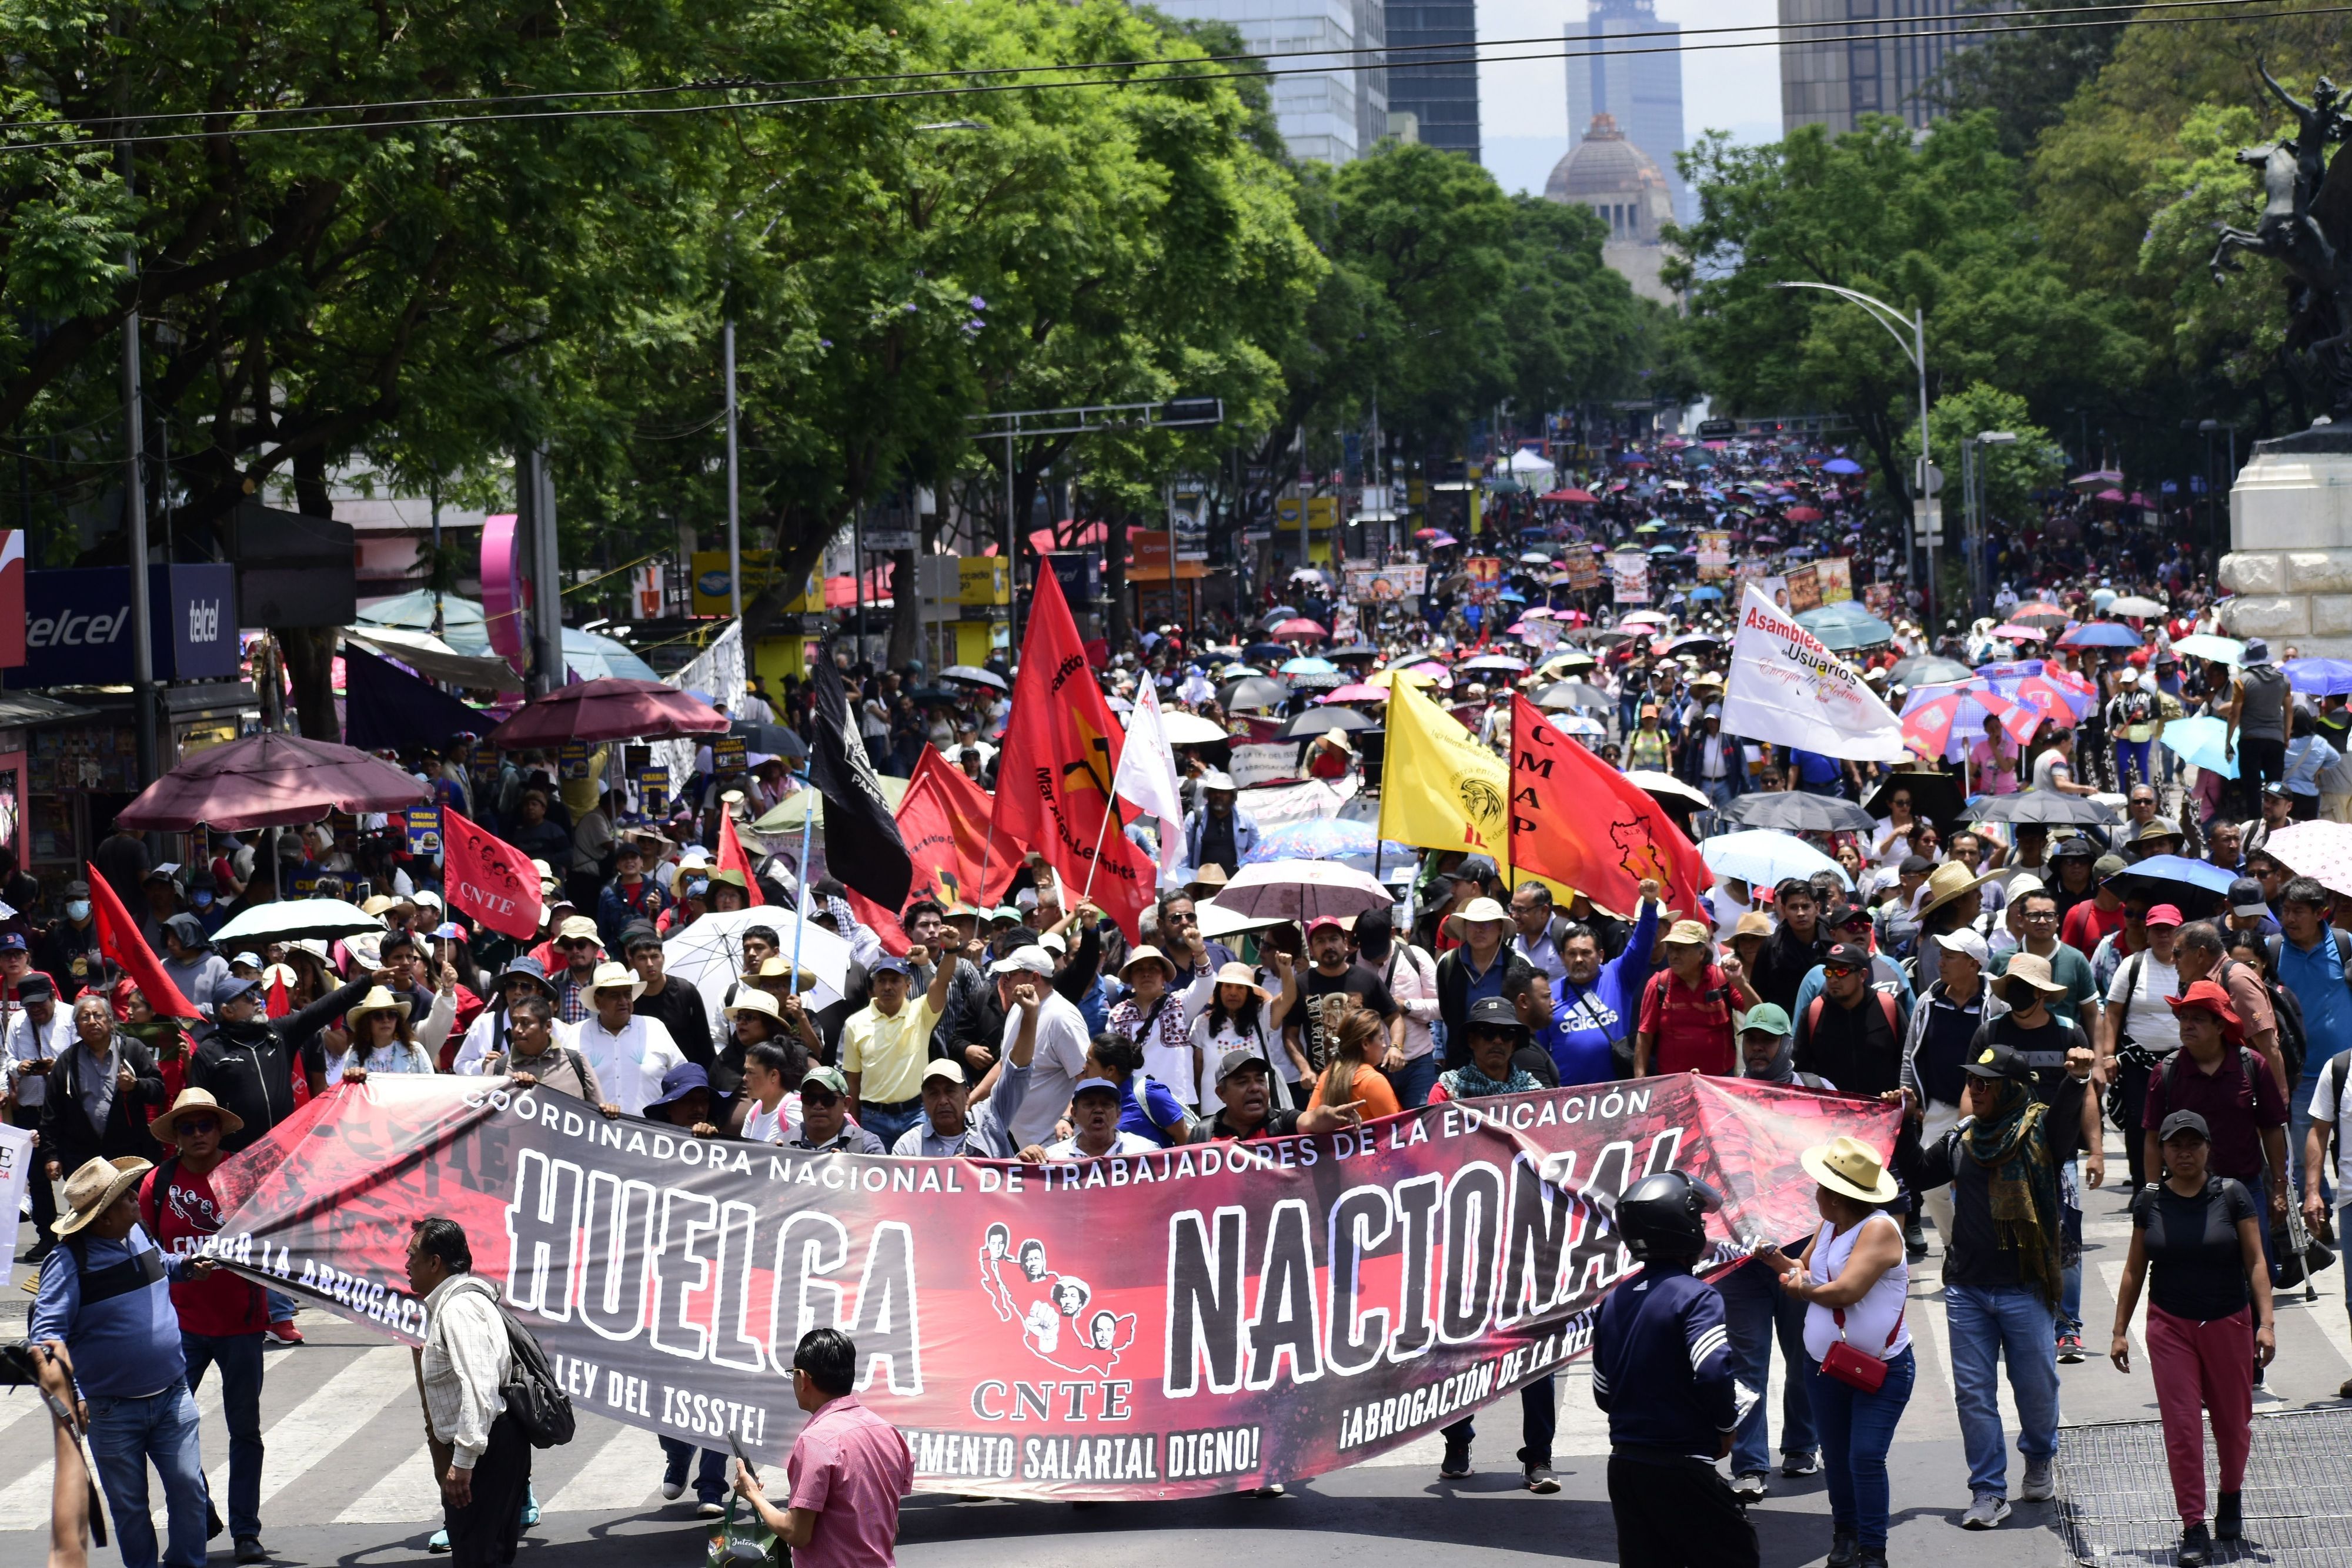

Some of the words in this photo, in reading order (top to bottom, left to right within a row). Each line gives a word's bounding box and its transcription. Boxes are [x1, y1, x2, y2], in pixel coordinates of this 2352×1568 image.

[190, 599, 219, 643] telcel
[1745, 607, 1825, 654] Asamblea
[1788, 643, 1857, 686] Usuarios
[460, 881, 516, 917] CNTE
[1305, 994, 1325, 1070] ZAPATA
[1559, 1009, 1618, 1033] adidas
[462, 1088, 752, 1175] COORDINADORA
[769, 1155, 963, 1192] NACIONAL
[979, 1167, 1023, 1193] DE
[1044, 1138, 1319, 1191] TRABAJADORES
[1334, 1127, 1376, 1161] DE
[1391, 1118, 1429, 1151] LA
[1443, 1086, 1652, 1138] EDUCACIÓN
[262, 1241, 291, 1279] LA
[298, 1258, 427, 1339] ABROGACI
[505, 1148, 925, 1396] HUELGA
[555, 1354, 599, 1399] LEY
[607, 1370, 651, 1418] DEL
[662, 1385, 766, 1446] ISSSTE!
[971, 1379, 1133, 1422] CNTE
[1339, 1365, 1494, 1449] ¡ABROGACIÓN
[1498, 1347, 1528, 1390] DE
[1526, 1333, 1555, 1374] LA
[907, 1430, 1014, 1478] EMENTO
[1024, 1437, 1157, 1479] SALARIAL
[1168, 1426, 1260, 1477] DIGNO!
